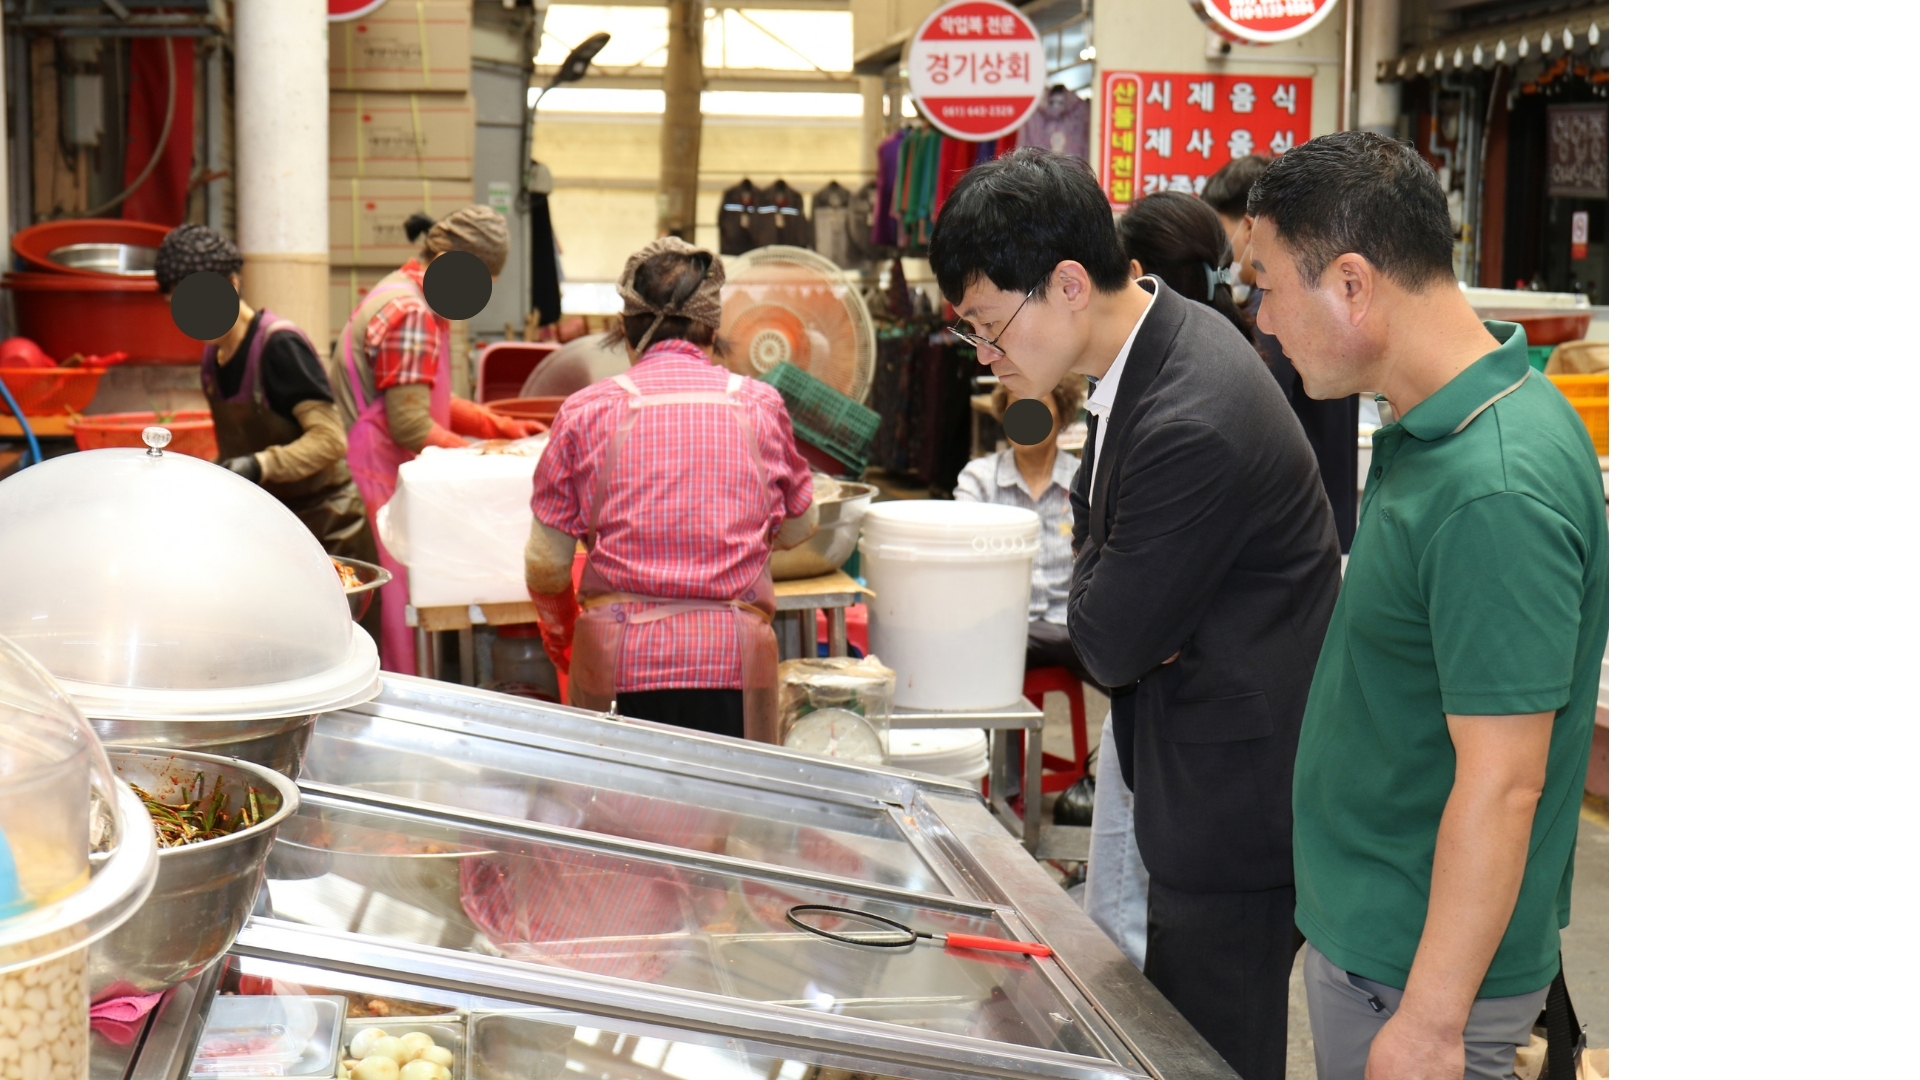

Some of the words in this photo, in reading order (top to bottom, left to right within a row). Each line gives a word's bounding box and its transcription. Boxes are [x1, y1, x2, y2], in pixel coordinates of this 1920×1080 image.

[940, 15, 983, 35] 작업복
[986, 15, 1016, 35] 전문
[926, 52, 1030, 84] 경기상회
[1111, 81, 1136, 202] 산들네전집
